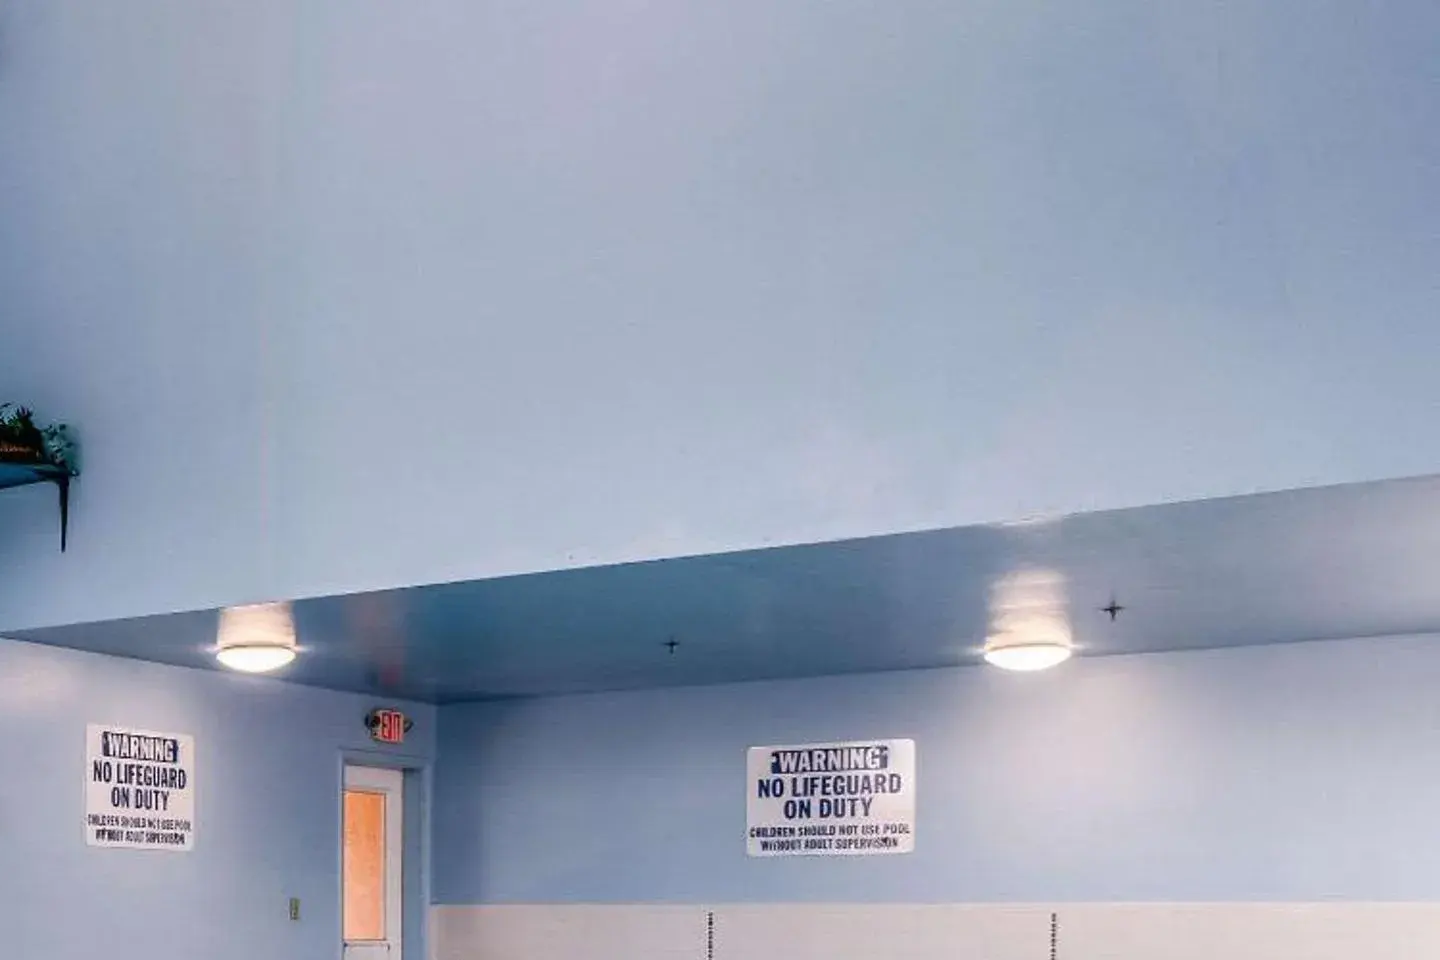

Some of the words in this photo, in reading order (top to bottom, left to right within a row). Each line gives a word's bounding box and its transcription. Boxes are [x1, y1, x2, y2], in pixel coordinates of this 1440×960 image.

[107, 733, 175, 762] WARNING
[778, 748, 882, 774] WARNING
[93, 760, 112, 782] NO
[116, 763, 187, 789] LIFEGUARD
[757, 778, 784, 798] NO
[791, 774, 902, 798] LIFEGUARD
[111, 787, 130, 808] ON
[135, 789, 170, 811] DUTY
[784, 799, 811, 819] ON
[819, 797, 873, 818] DUTY
[750, 826, 796, 838] CHILDREN
[798, 825, 836, 837] SHOULD
[838, 825, 858, 836] NOT
[861, 824, 880, 835] USE
[804, 838, 833, 850] ADULT
